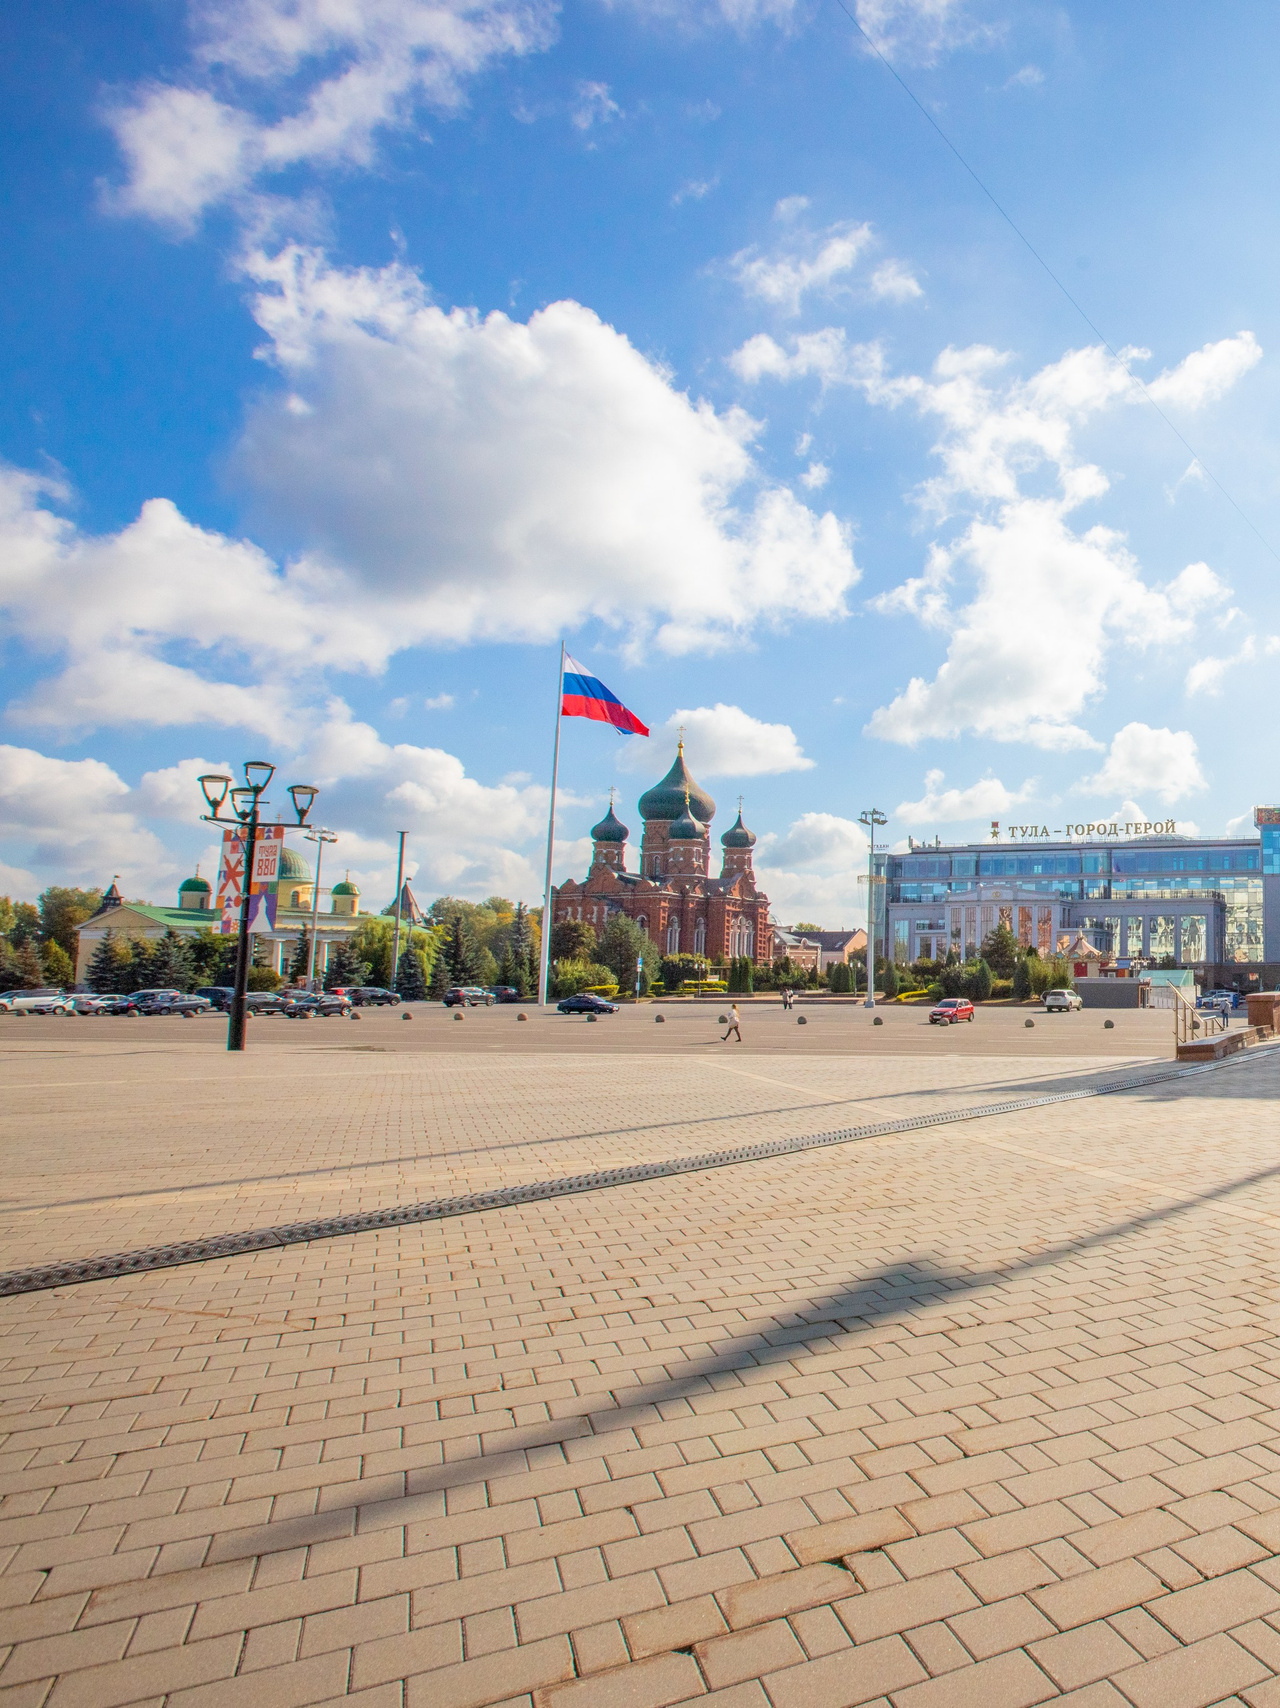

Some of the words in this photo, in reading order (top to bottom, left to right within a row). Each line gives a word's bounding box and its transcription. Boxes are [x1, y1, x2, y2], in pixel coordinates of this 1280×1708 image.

[1008, 825, 1050, 838] ТУЛА
[1065, 819, 1176, 837] ГОРОД-ГЕРОЙ
[259, 845, 278, 857] ТУЛА
[257, 858, 276, 876] 880
